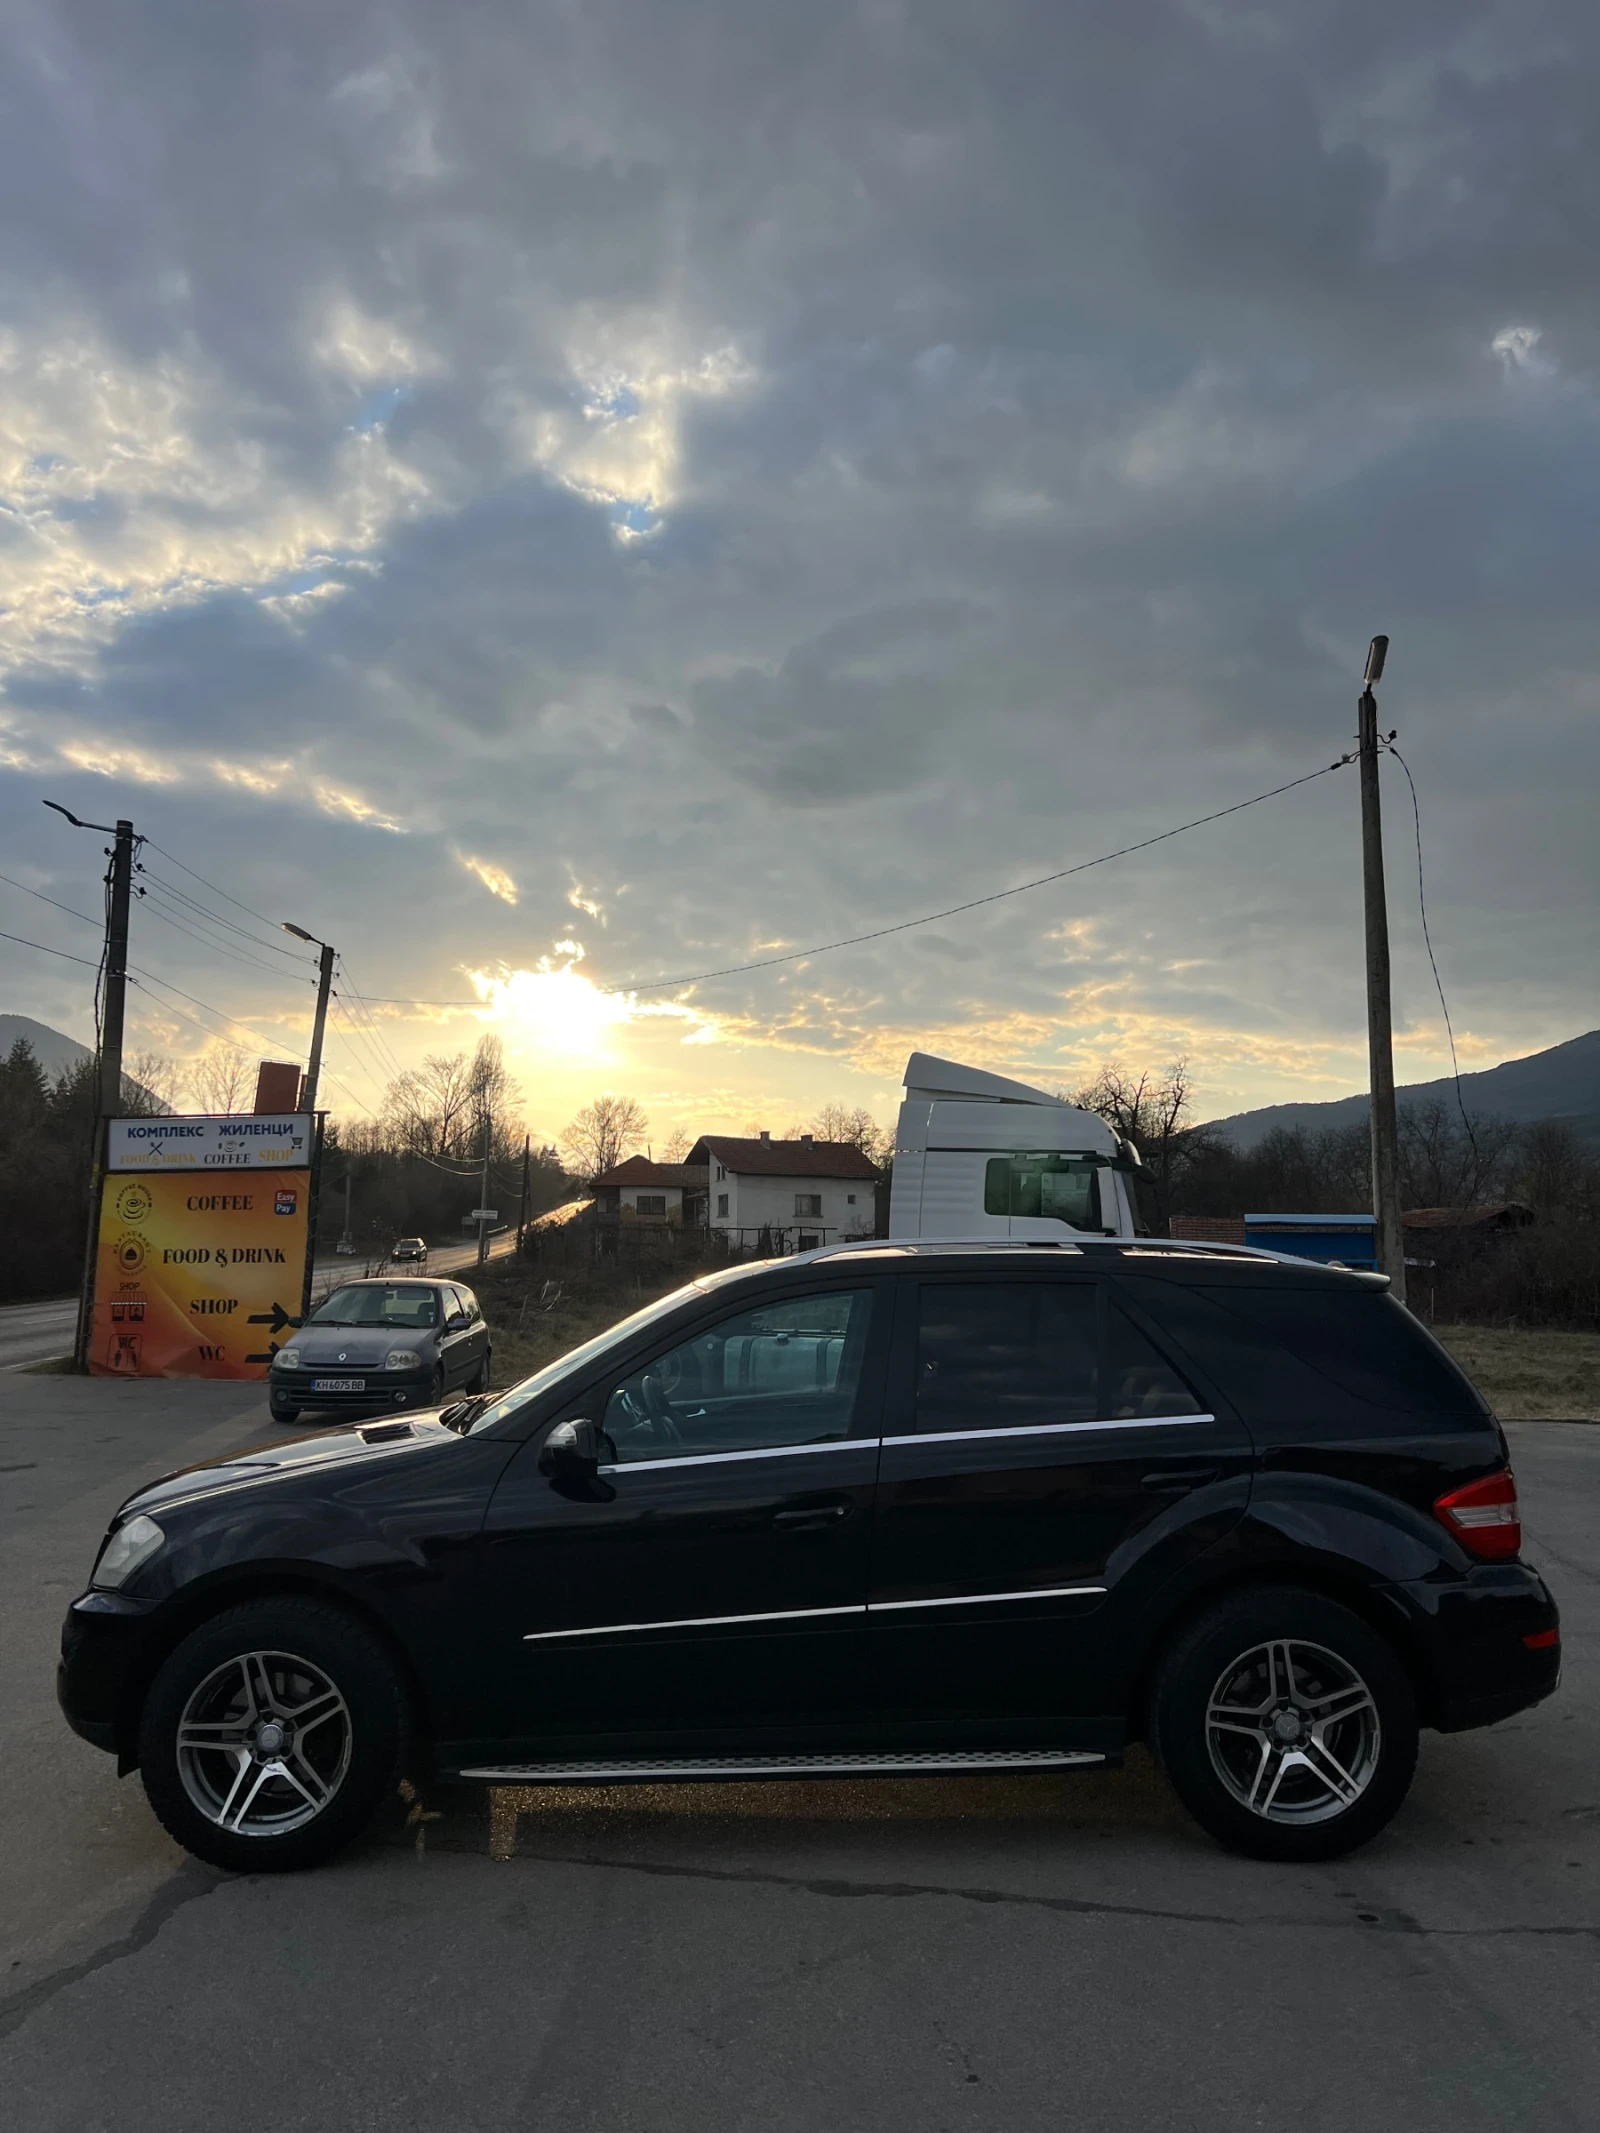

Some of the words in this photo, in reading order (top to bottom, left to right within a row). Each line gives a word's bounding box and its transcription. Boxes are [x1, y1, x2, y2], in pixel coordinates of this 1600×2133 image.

[127, 1126, 205, 1139] КОМПЛЕКС
[218, 1123, 294, 1137] ЖИЛЕНЦИ
[119, 1153, 150, 1164] FOOD
[162, 1152, 197, 1164] DRINK
[204, 1153, 251, 1165] COFFEE
[258, 1148, 294, 1163] SHOP
[186, 1195, 253, 1212] COFFEE
[276, 1192, 296, 1202] Easy
[276, 1204, 291, 1214] Pay
[163, 1248, 210, 1264] FOOD
[215, 1247, 228, 1268] &
[231, 1247, 287, 1264] DRINK
[119, 1282, 140, 1291] SHOP
[189, 1299, 239, 1315] SHOP
[117, 1336, 136, 1350] WC
[198, 1345, 226, 1362] WC
